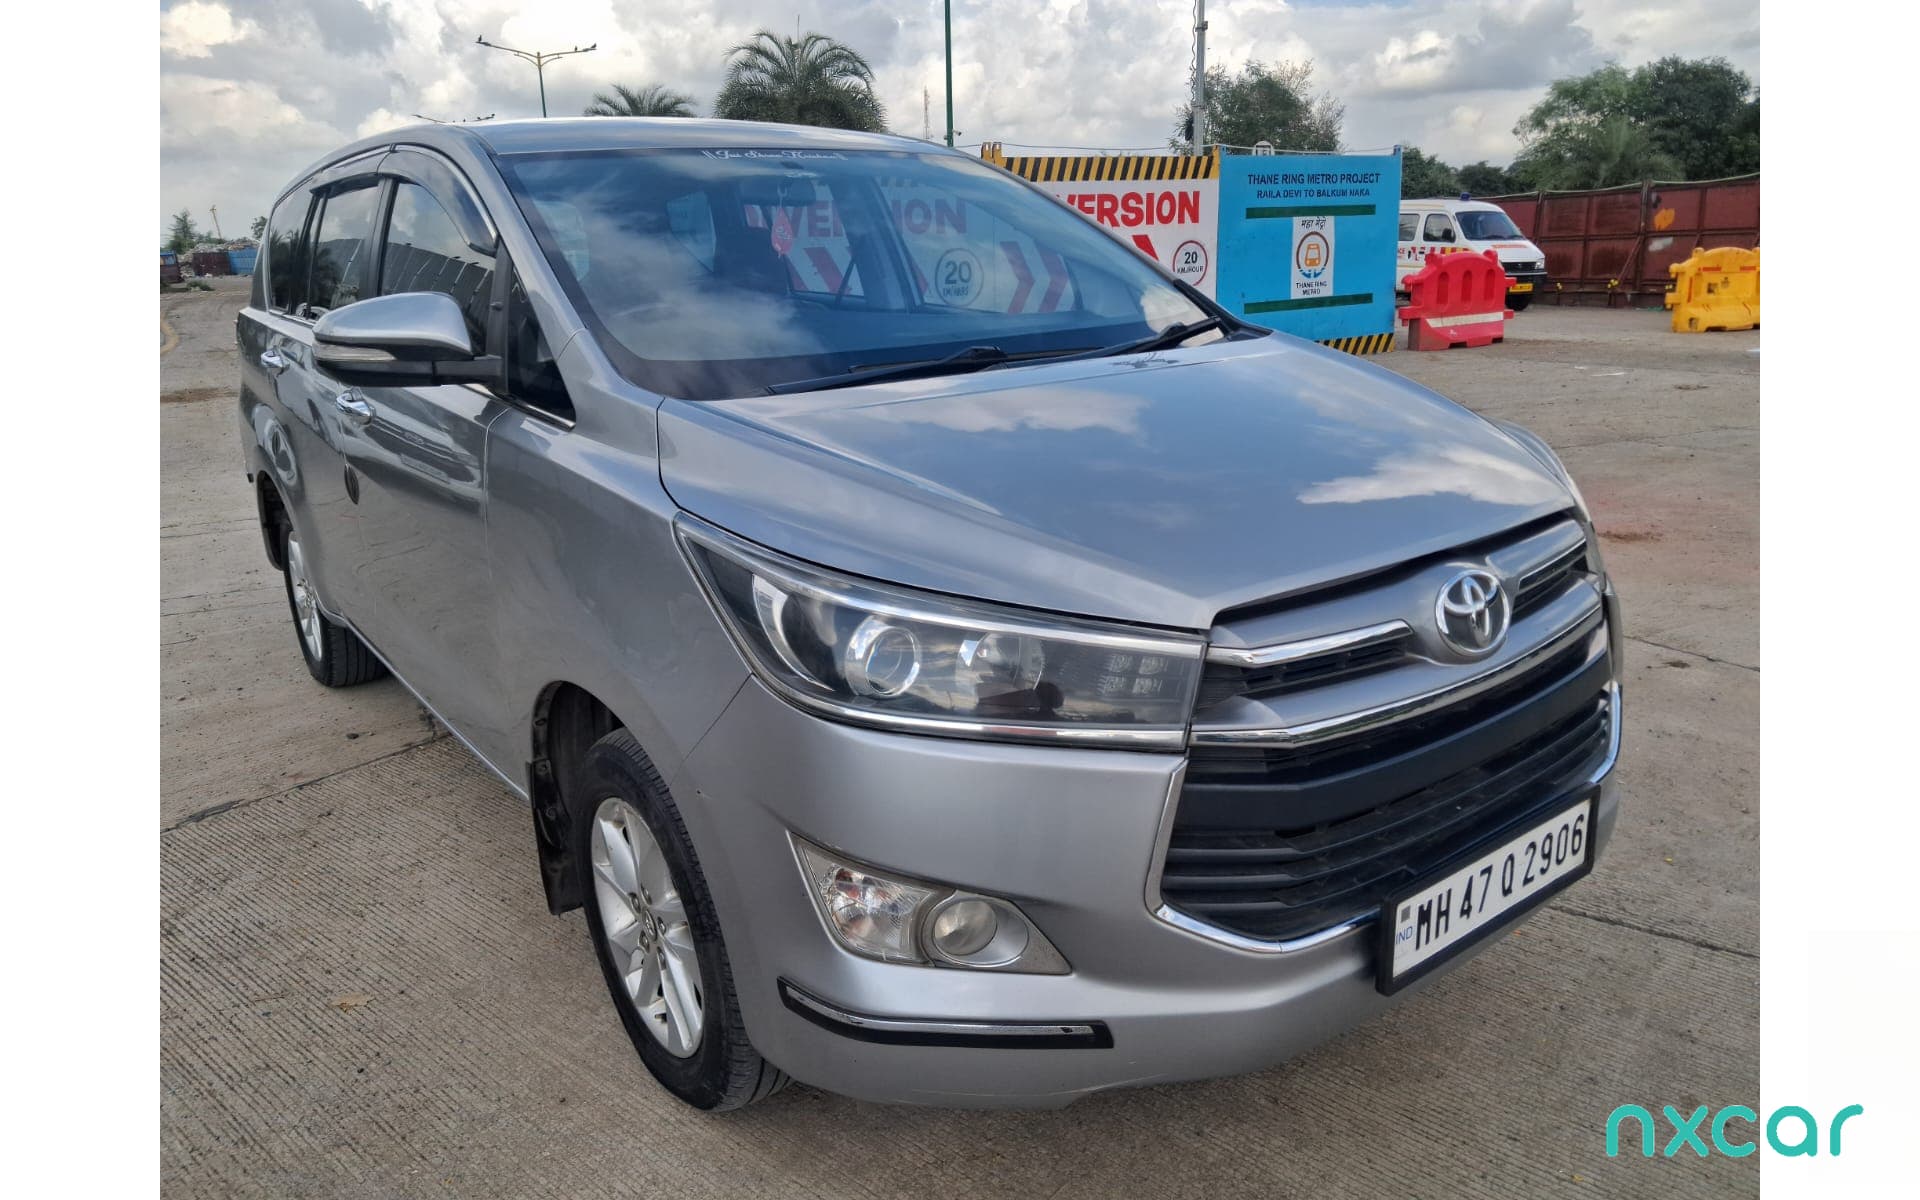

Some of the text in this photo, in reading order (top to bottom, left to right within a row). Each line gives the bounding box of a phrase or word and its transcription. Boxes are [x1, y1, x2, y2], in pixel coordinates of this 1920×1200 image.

[1248, 173, 1381, 185] THANE RING METRO PROJECT
[1257, 188, 1370, 199] RAILA DEVI TO BALKUM NAKA
[1184, 251, 1198, 264] 20
[944, 260, 972, 285] 20
[1416, 813, 1585, 951] MH 47 Q 2906
[1395, 926, 1413, 944] IND
